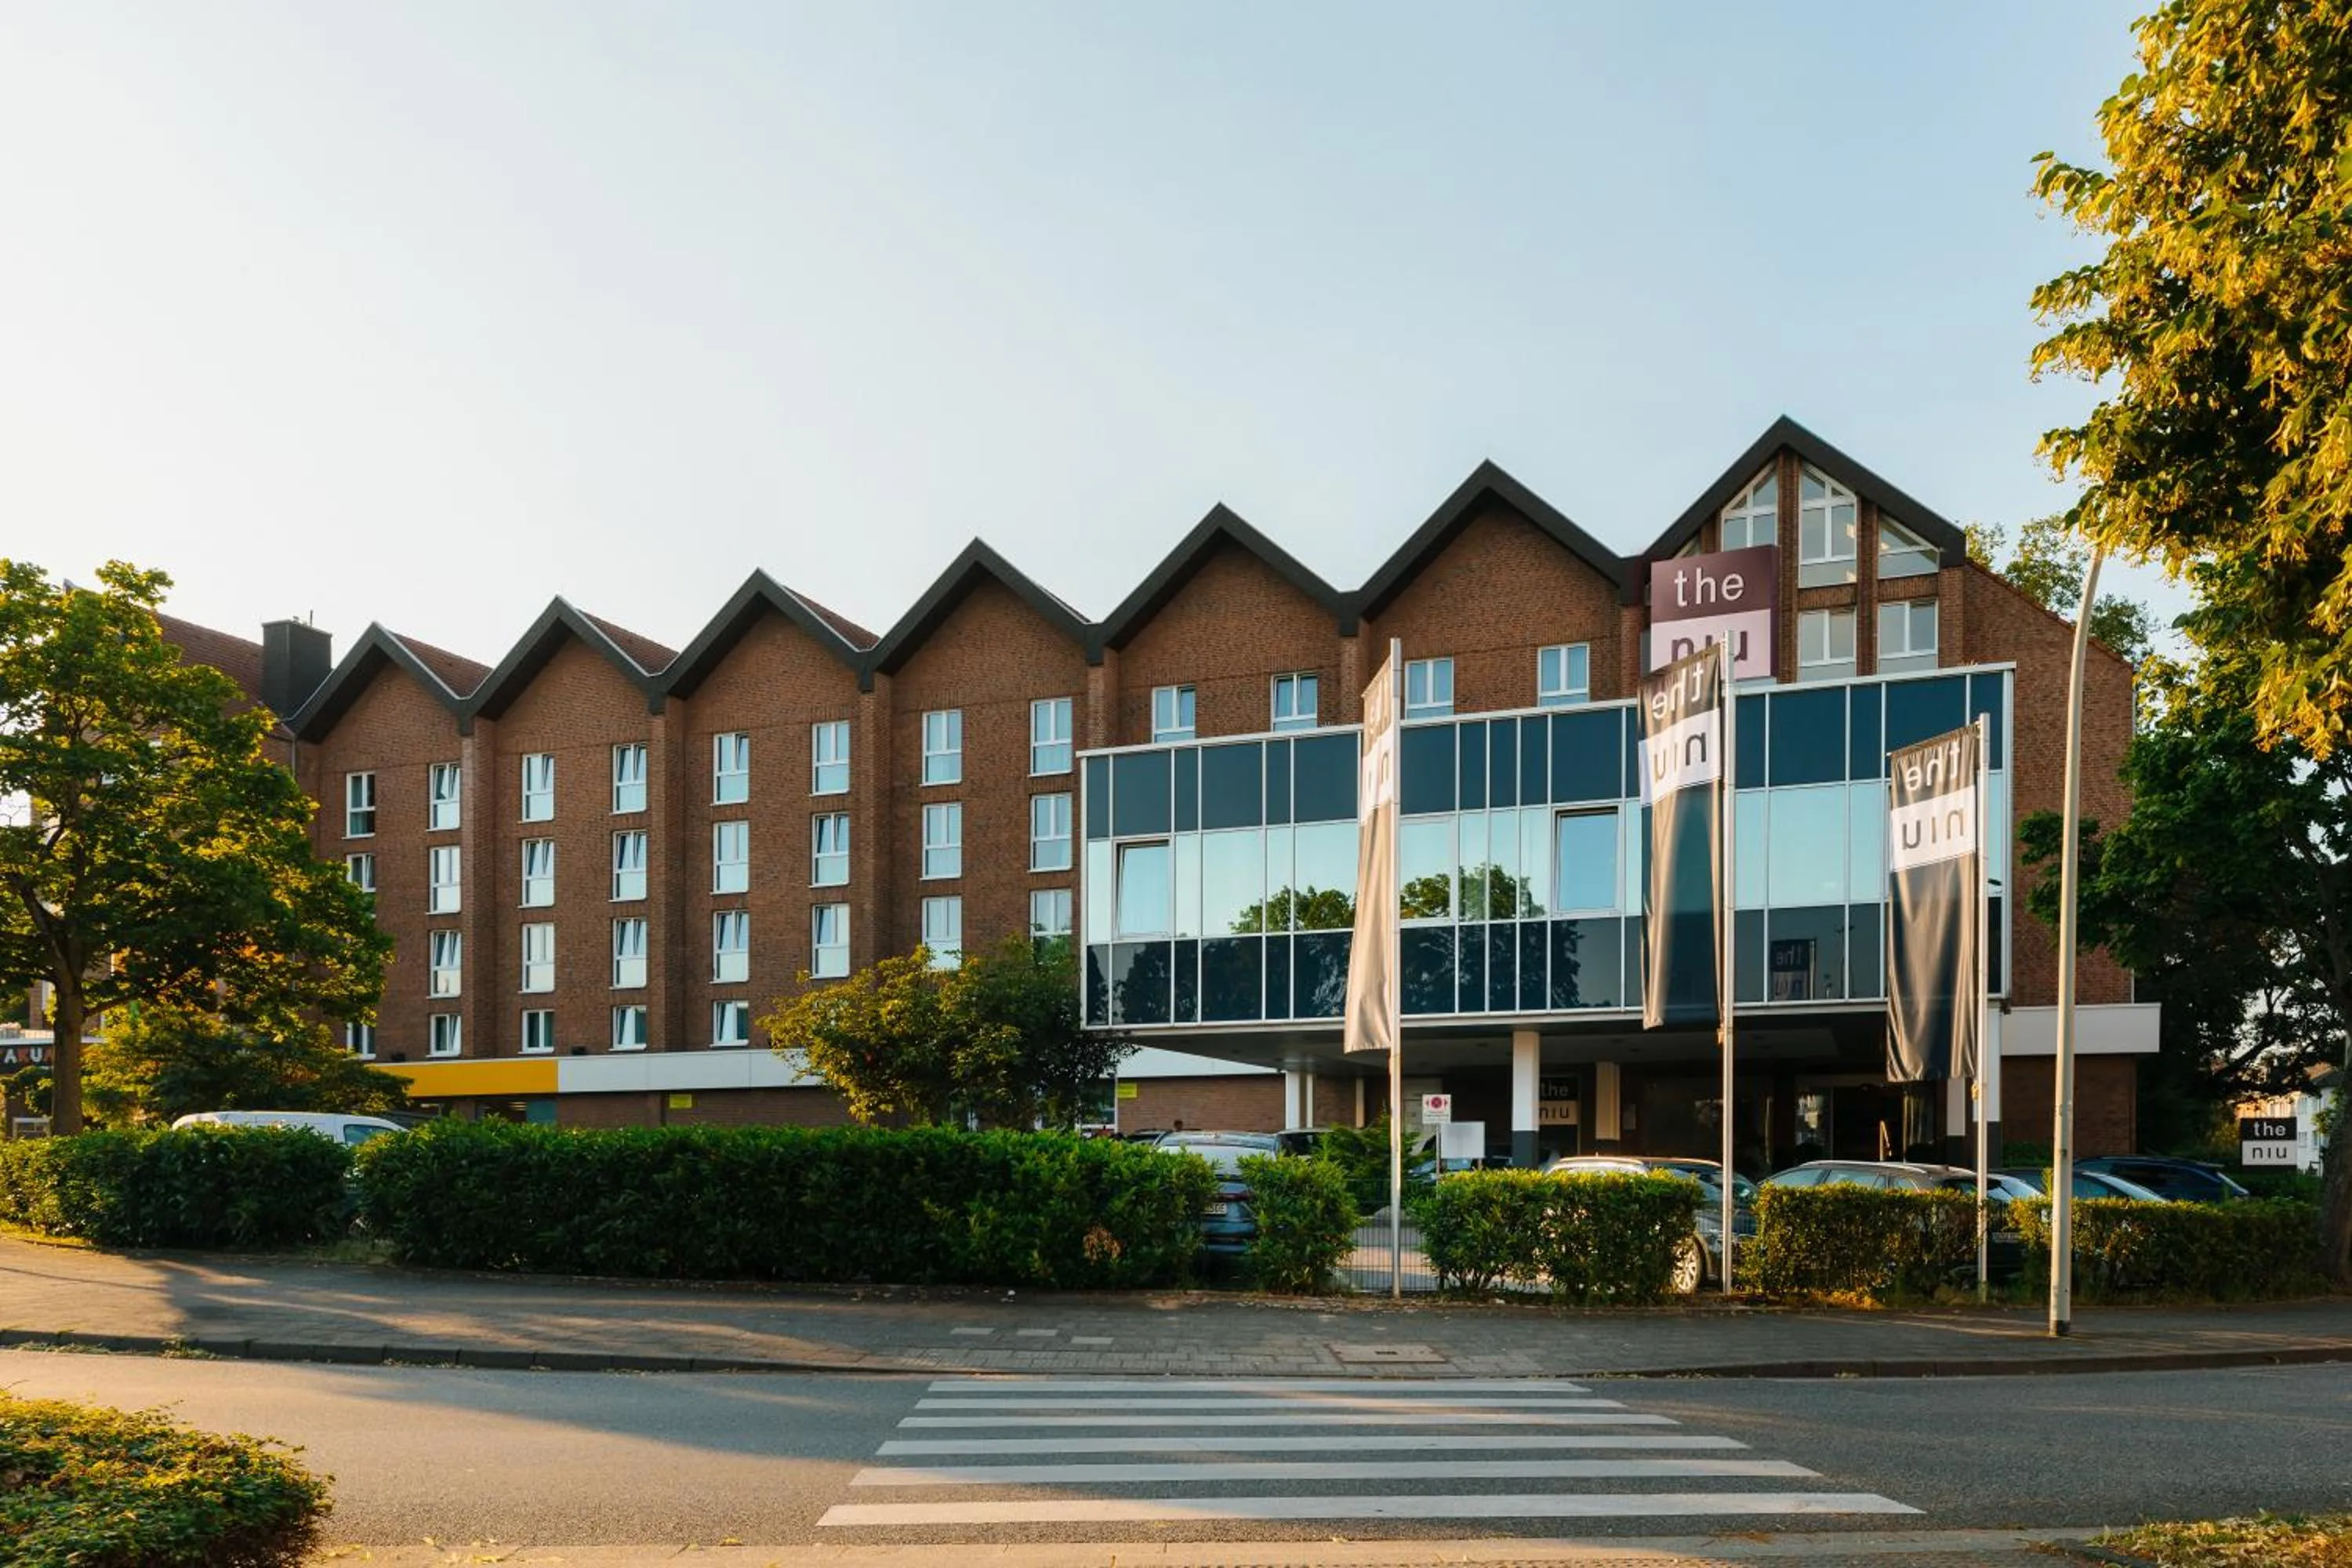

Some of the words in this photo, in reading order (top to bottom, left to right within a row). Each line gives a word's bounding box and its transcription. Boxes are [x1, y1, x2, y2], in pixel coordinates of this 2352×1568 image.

[1674, 567, 1744, 607] the
[2253, 1121, 2286, 1137] the
[2252, 1146, 2287, 1160] niu
